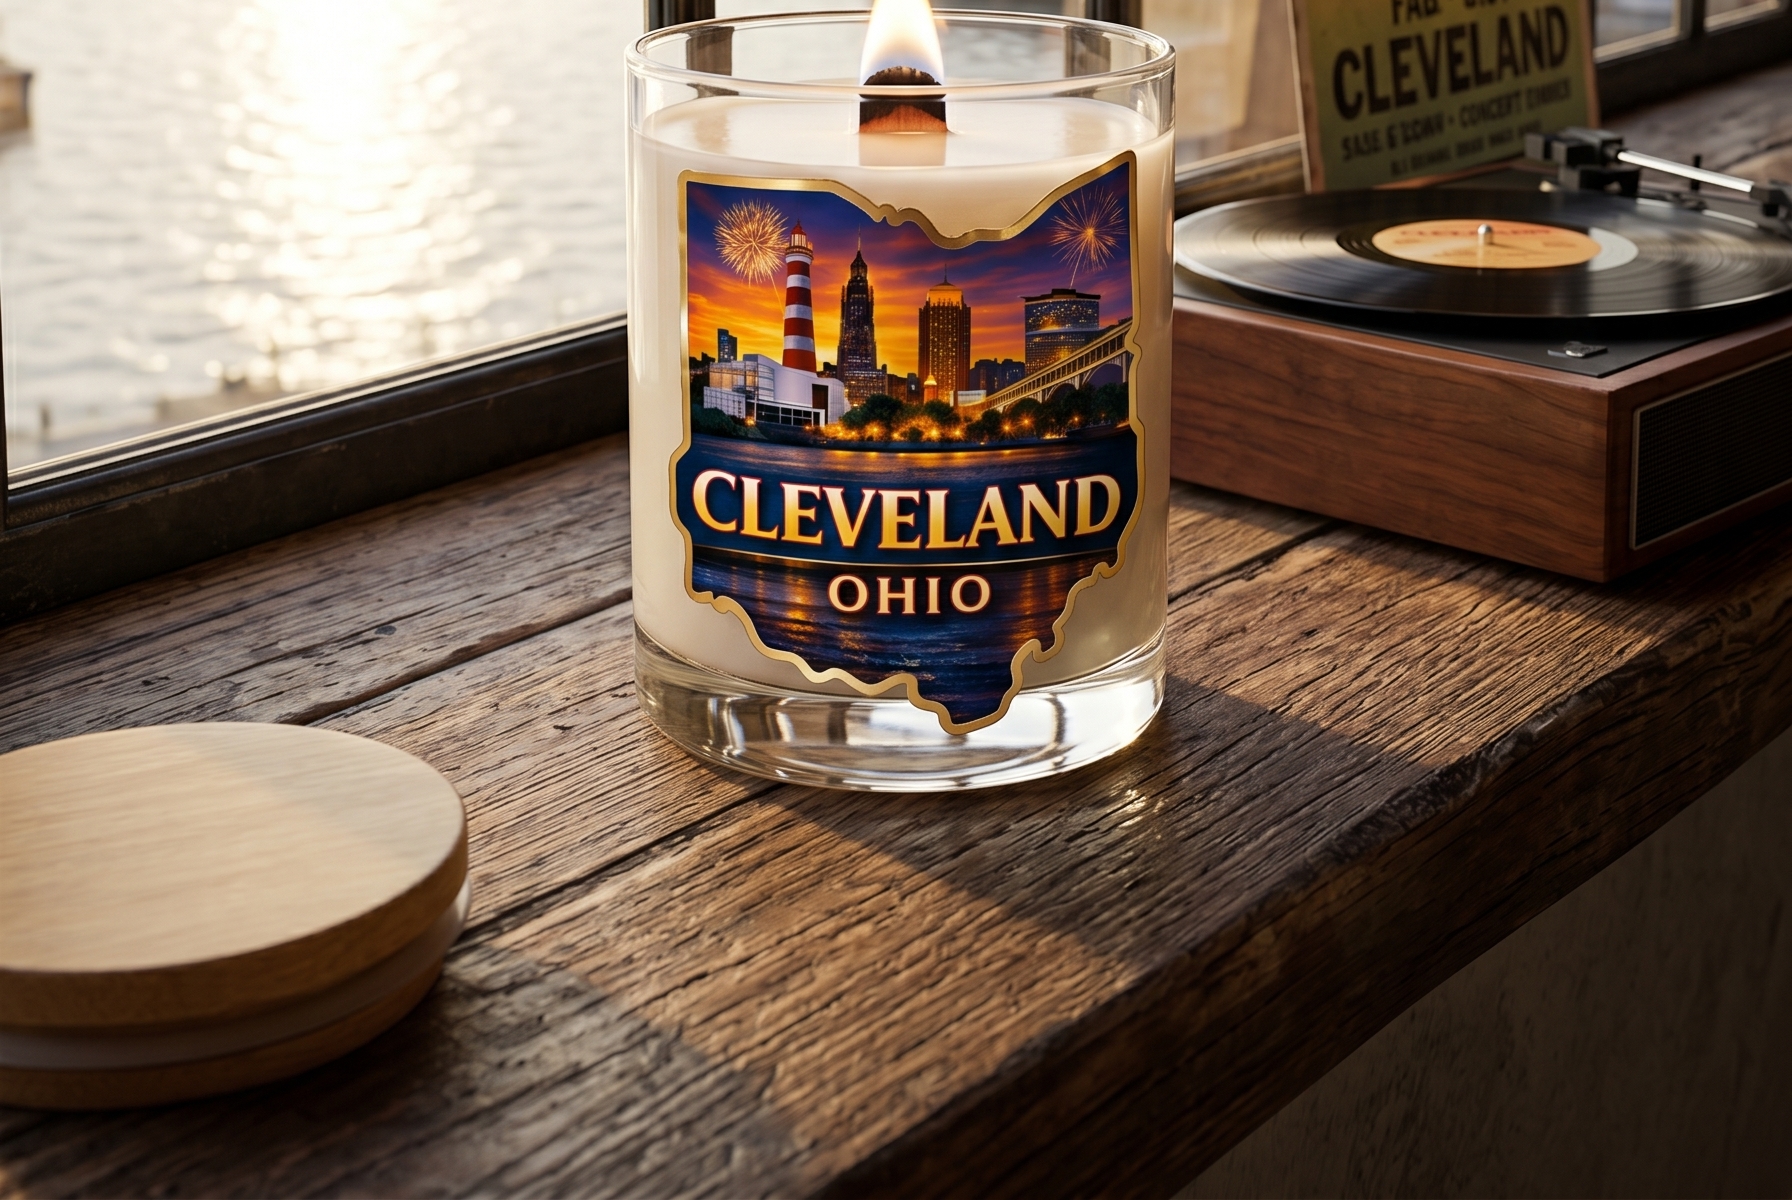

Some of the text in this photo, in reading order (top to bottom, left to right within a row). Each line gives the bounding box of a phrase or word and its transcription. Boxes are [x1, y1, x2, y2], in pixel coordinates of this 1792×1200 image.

[1332, 4, 1569, 122] CLEVELAND
[692, 469, 1121, 550] CLEVELAND
[828, 574, 991, 615] OHIO
